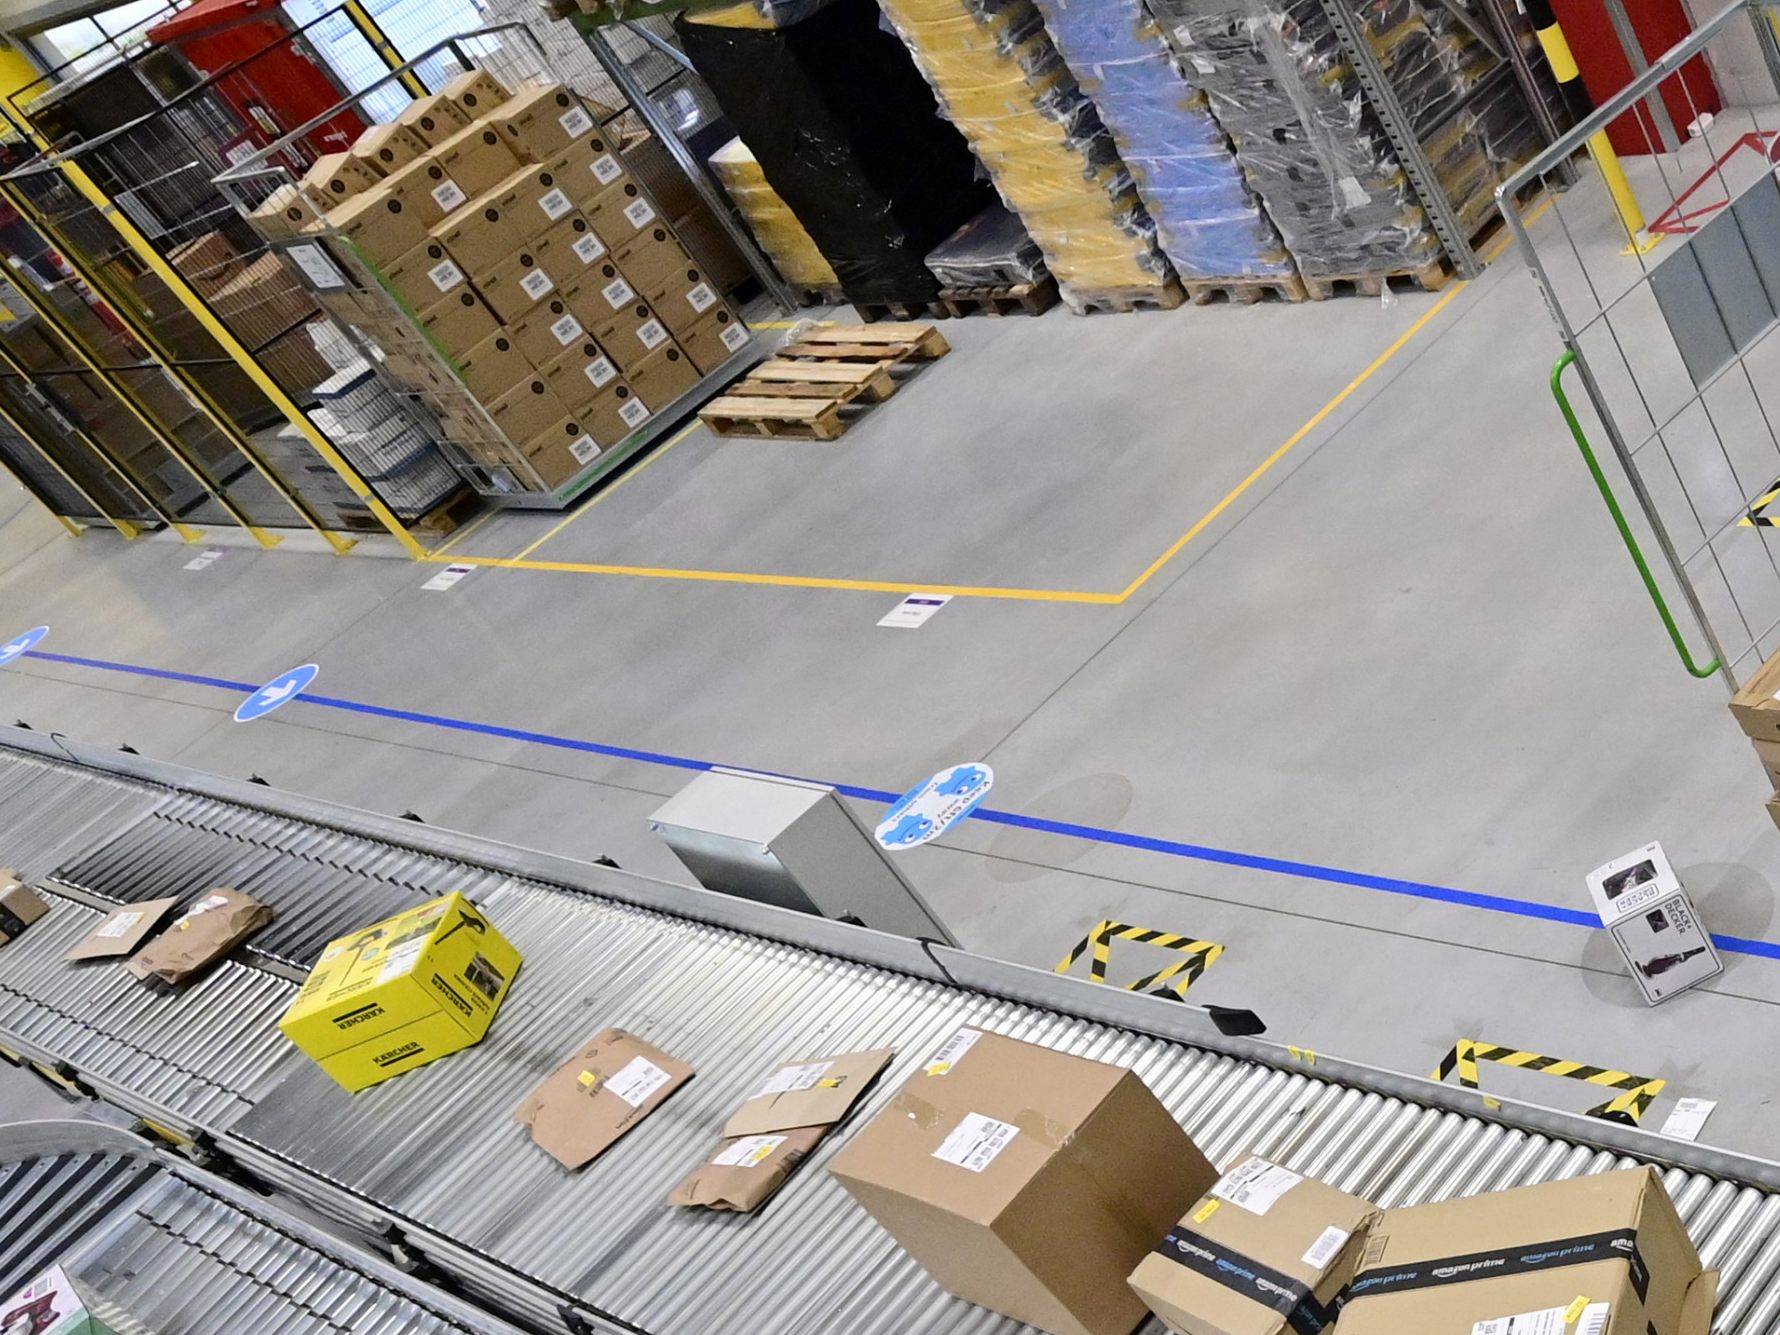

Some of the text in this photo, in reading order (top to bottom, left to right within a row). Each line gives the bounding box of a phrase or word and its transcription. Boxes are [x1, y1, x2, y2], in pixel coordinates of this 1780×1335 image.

[1664, 903, 1686, 935] DECKER
[1559, 1242, 1596, 1260] prime
[1431, 1258, 1506, 1278] amazon prime
[1382, 1271, 1418, 1286] prime
